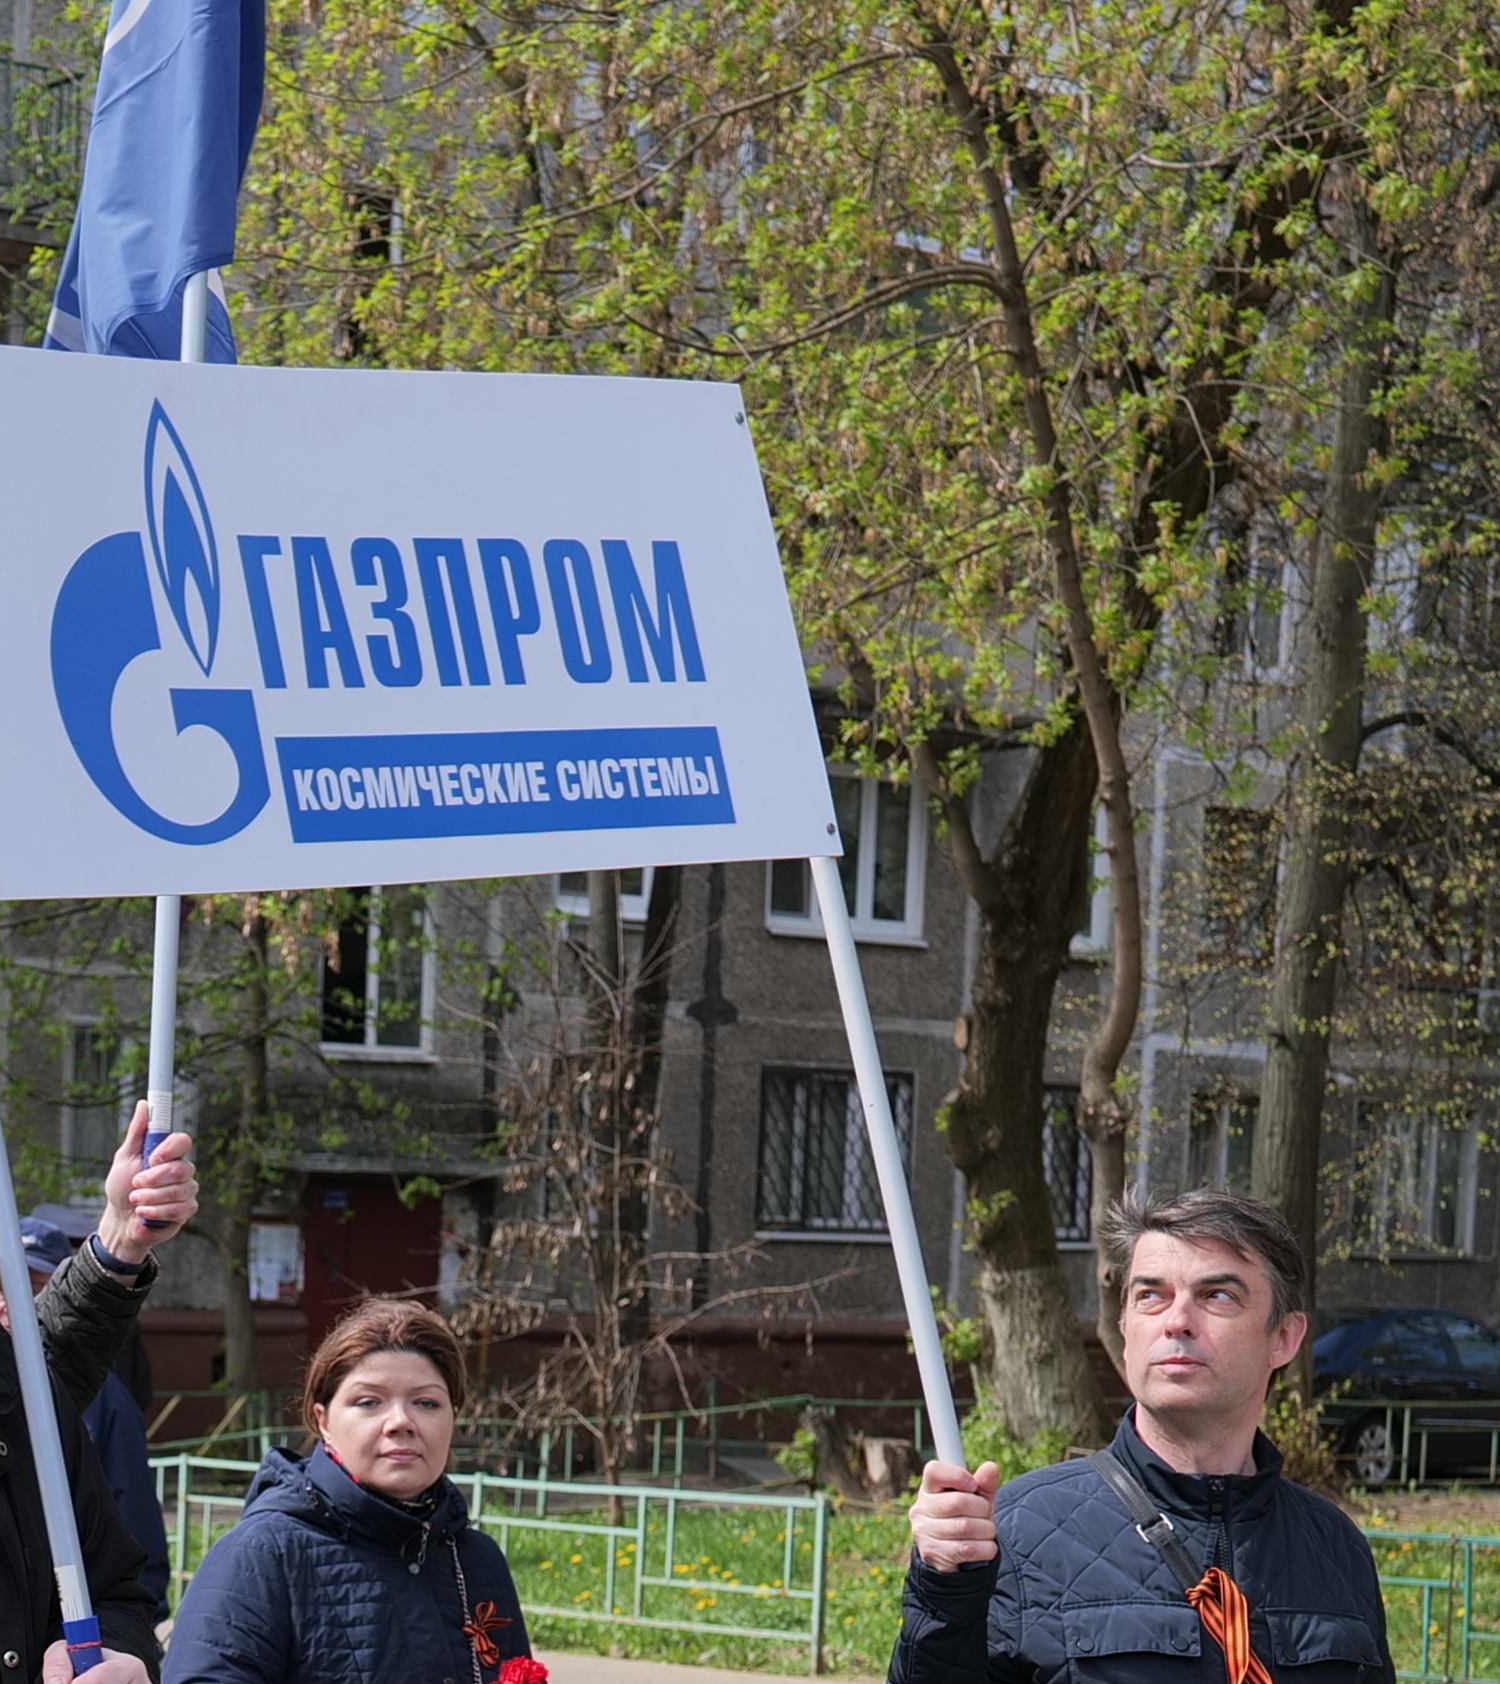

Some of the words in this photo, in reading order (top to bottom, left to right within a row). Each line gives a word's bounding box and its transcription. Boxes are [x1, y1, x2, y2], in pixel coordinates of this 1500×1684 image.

[238, 534, 707, 689] ГАЗПРОМ
[294, 760, 551, 812] КОСМИЧЕСКИЕ
[555, 753, 720, 801] СИСТЕМЫ
